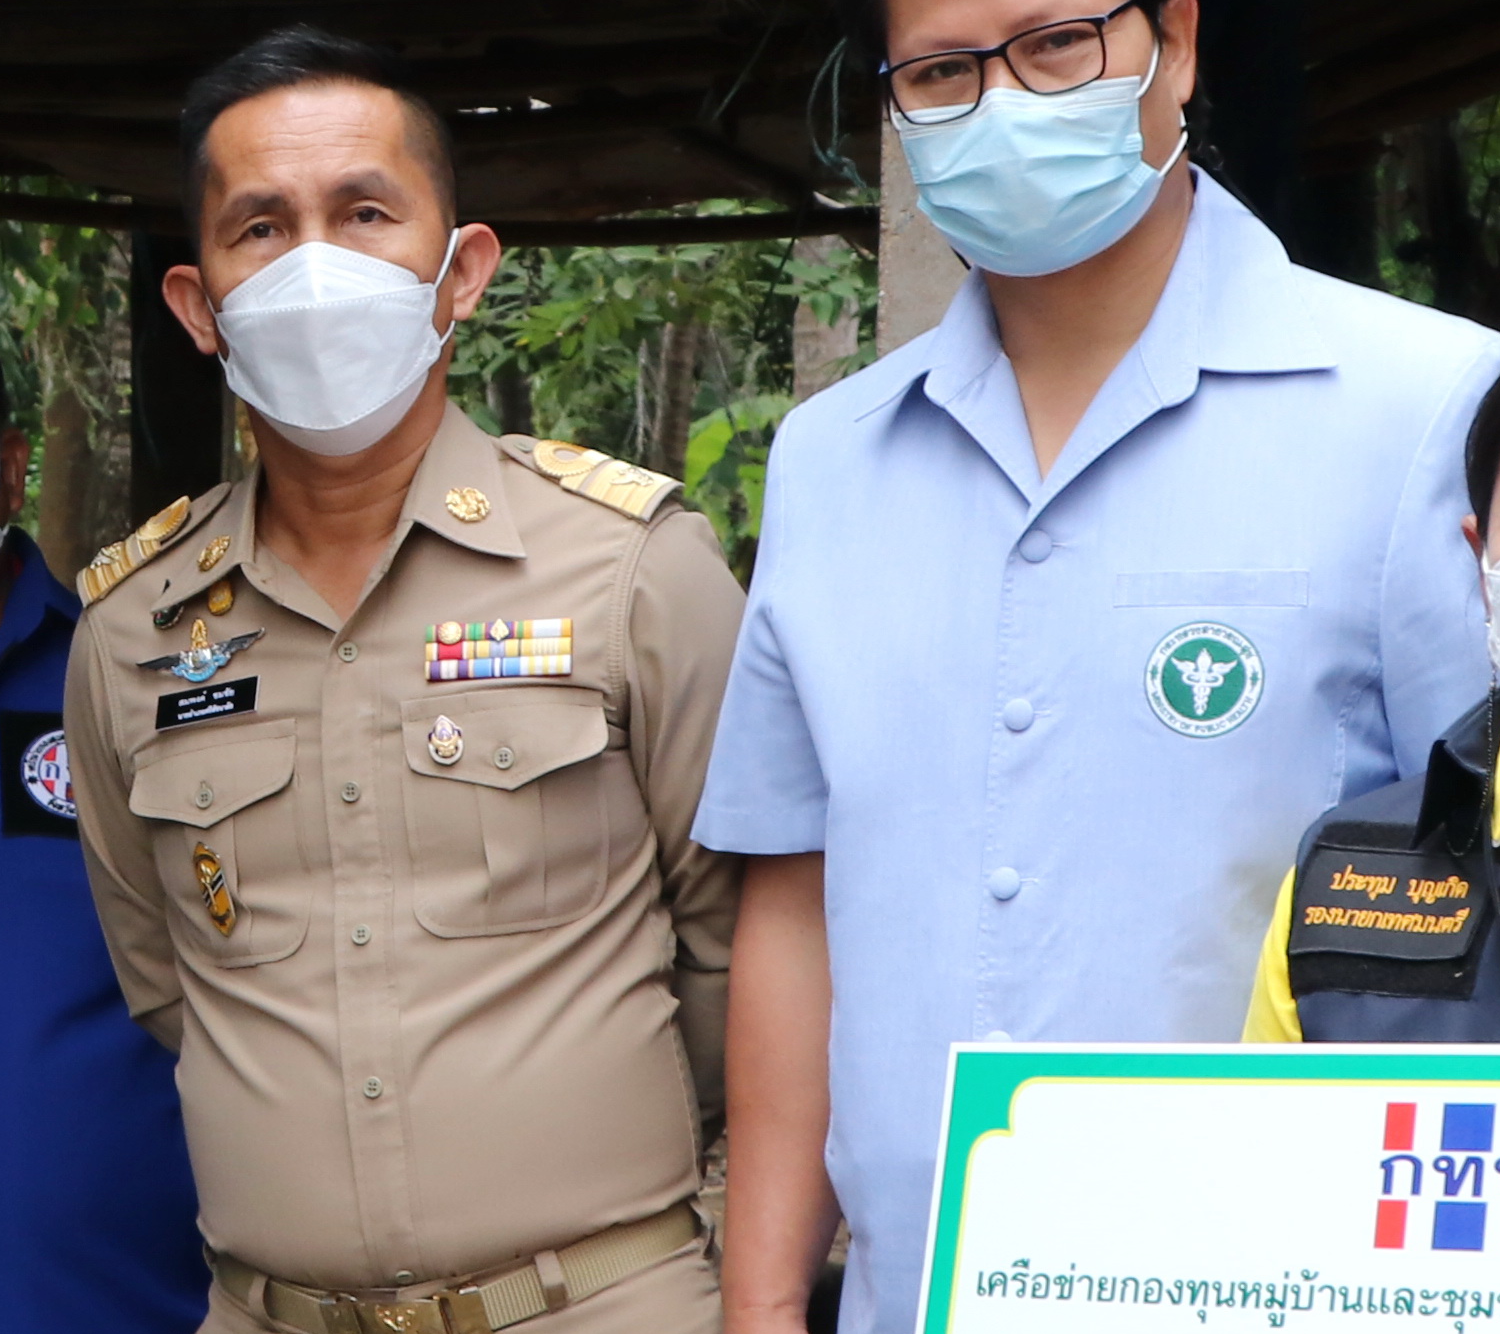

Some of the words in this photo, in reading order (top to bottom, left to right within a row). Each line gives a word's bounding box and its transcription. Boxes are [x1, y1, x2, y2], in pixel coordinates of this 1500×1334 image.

[1304, 905, 1472, 935] รองนายกเทศมนตรี
